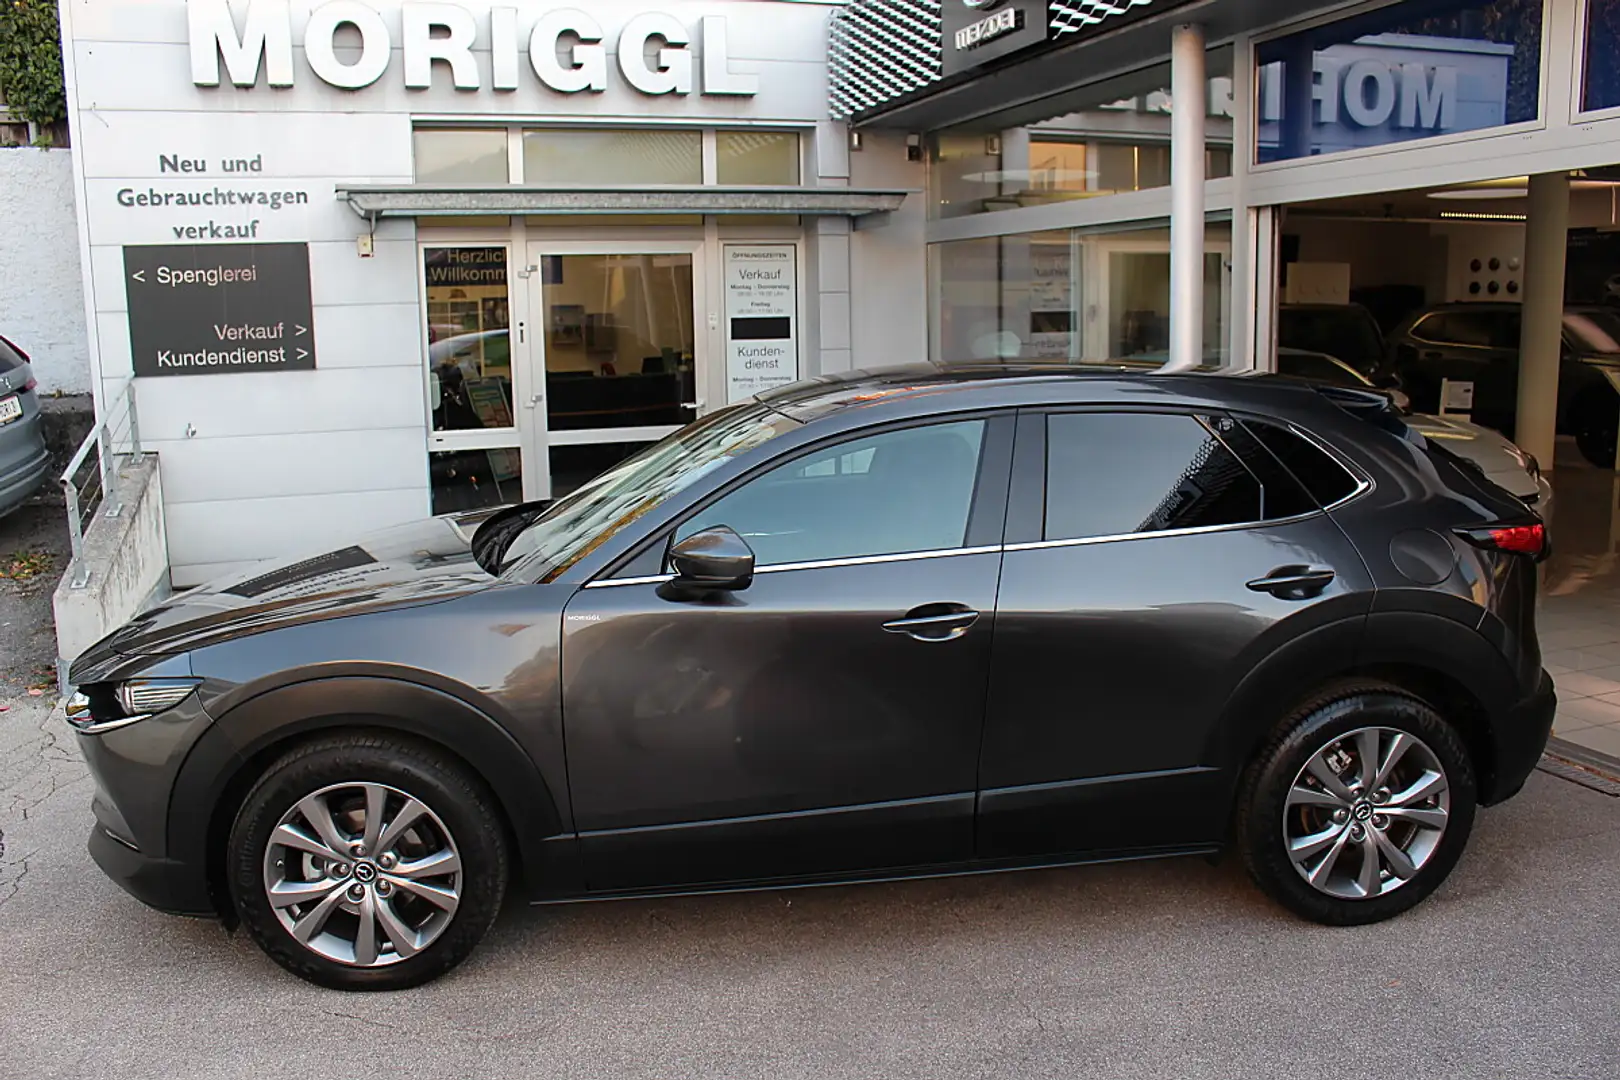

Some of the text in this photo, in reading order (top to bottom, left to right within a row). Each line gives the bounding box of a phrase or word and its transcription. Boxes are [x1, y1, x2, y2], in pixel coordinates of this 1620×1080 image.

[187, 0, 759, 97] MORIGGL
[159, 154, 262, 173] Neu und
[117, 187, 308, 210] Gebrauchtwagen
[173, 220, 259, 239] verkauf
[157, 265, 257, 287] Spenglerei
[738, 268, 781, 280] Verkauf
[214, 322, 284, 341] Verkauf
[157, 347, 286, 367] Kundendienst
[737, 346, 785, 358] Kunden-
[745, 358, 779, 369] dienst
